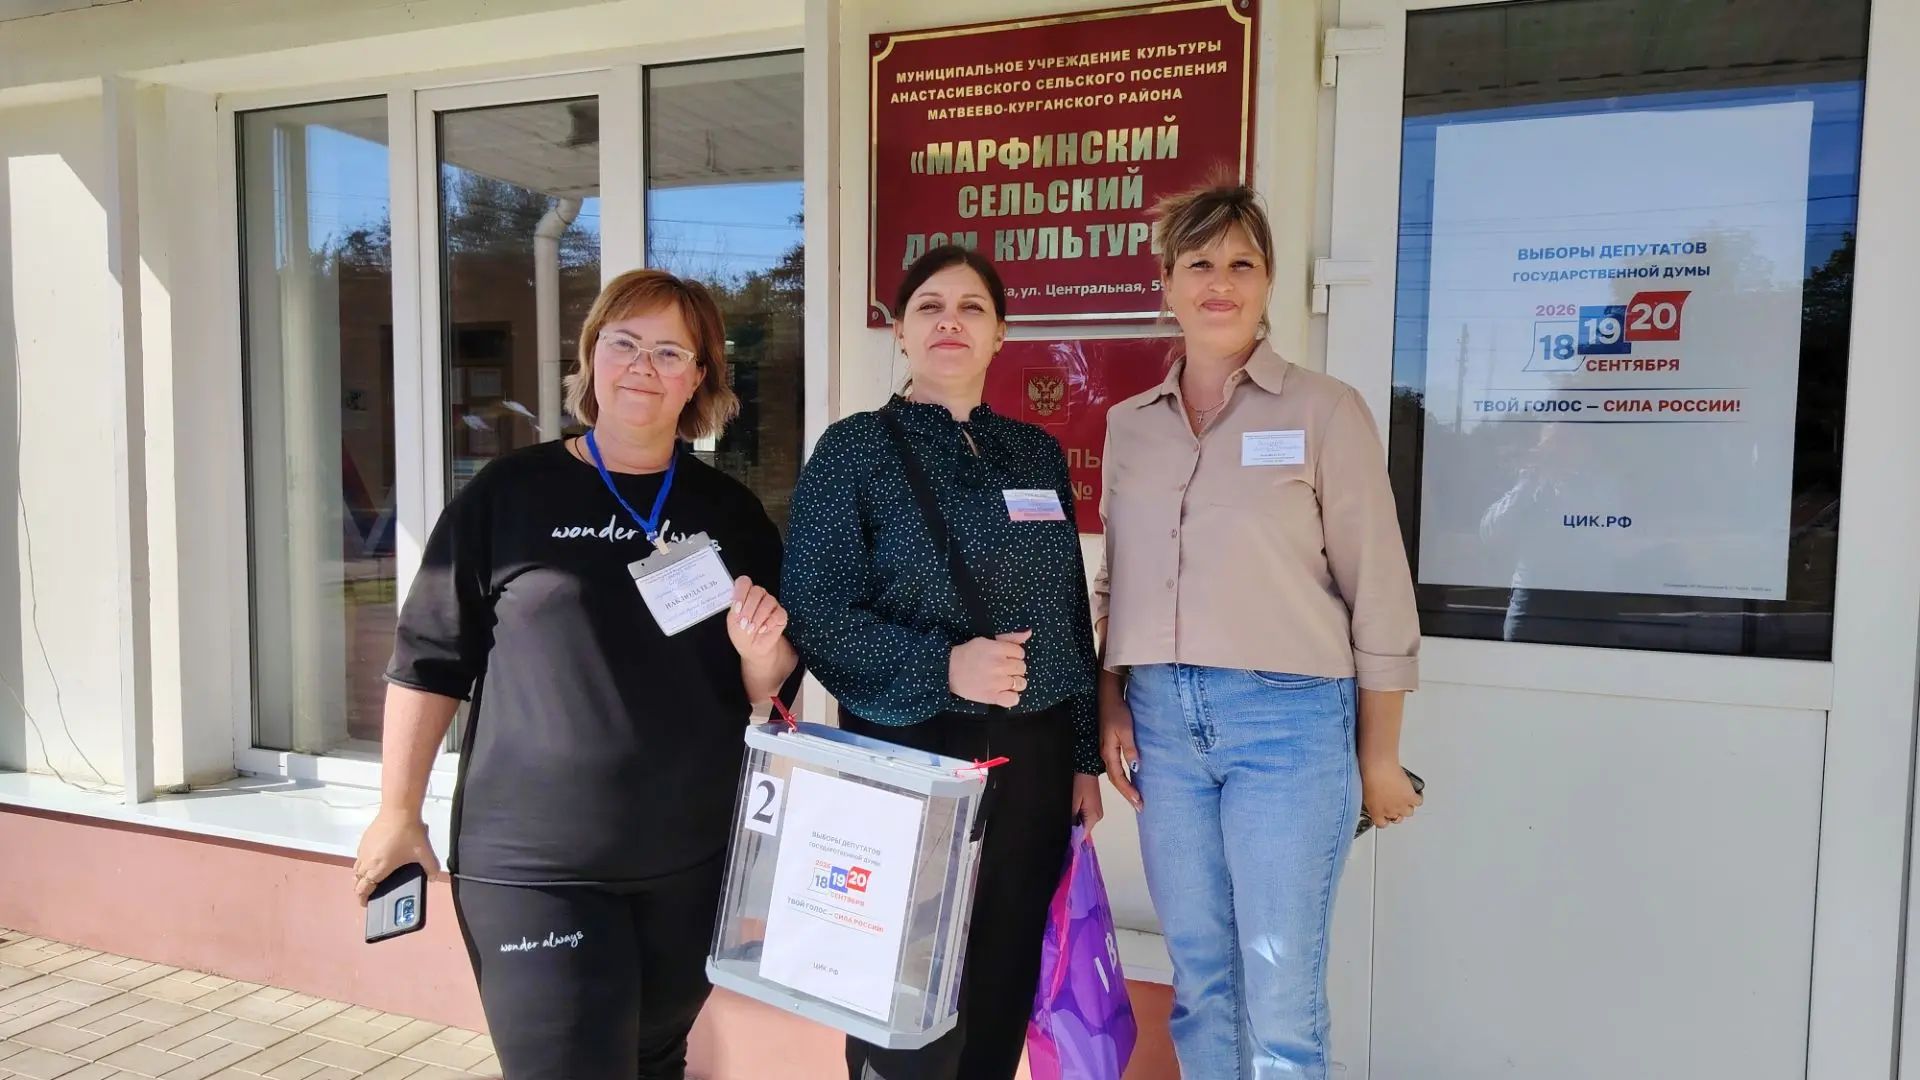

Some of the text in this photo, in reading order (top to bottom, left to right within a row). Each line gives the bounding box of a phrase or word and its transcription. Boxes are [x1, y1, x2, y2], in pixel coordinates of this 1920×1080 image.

[896, 40, 1222, 84] МУНИЦИПАЛЬНОЕ УЧРЕЖДЕНИЕ КУЛЬТУРЫ
[890, 61, 1227, 104] АНАСТАСИЕВСКОГО СЕЛЬСКОГО ПОСЕЛЕНИЯ
[927, 88, 1183, 121] МАТВЕЕВО-КУРГАНСКОГО РАЙОНА
[910, 114, 1180, 176] «МАРФИНСКИЙ
[957, 166, 1144, 219] СЕЛЬСКИЙ
[1518, 242, 1708, 261] ВЫБОРЫ ДЕПУТАТОВ
[1513, 265, 1710, 282] ГОСУДАРСТВЕННОЙ ДУМЫ
[1020, 288, 1041, 298] ул.
[1046, 280, 1145, 297] Центральная,
[1535, 304, 1576, 316] 2026
[1539, 302, 1677, 360] 18 19 20
[1586, 358, 1680, 372] СЕНТЯБРЯ
[1474, 398, 1519, 412] ТВОЙ
[1525, 400, 1582, 412] ГОЛОС
[1603, 400, 1653, 412] СИЛА
[1658, 400, 1741, 412] РОССИИ!
[551, 514, 640, 543] wonder
[1563, 515, 1632, 528] ЦИК.РФ
[752, 780, 776, 824] 2
[812, 831, 881, 856] ВЫБОРЫ ДЕПУТАТОВ
[815, 870, 867, 888] 18 19 20
[787, 896, 805, 908] ТВОЙ
[805, 902, 828, 914] ГОЛОС
[500, 930, 584, 952] wonder always
